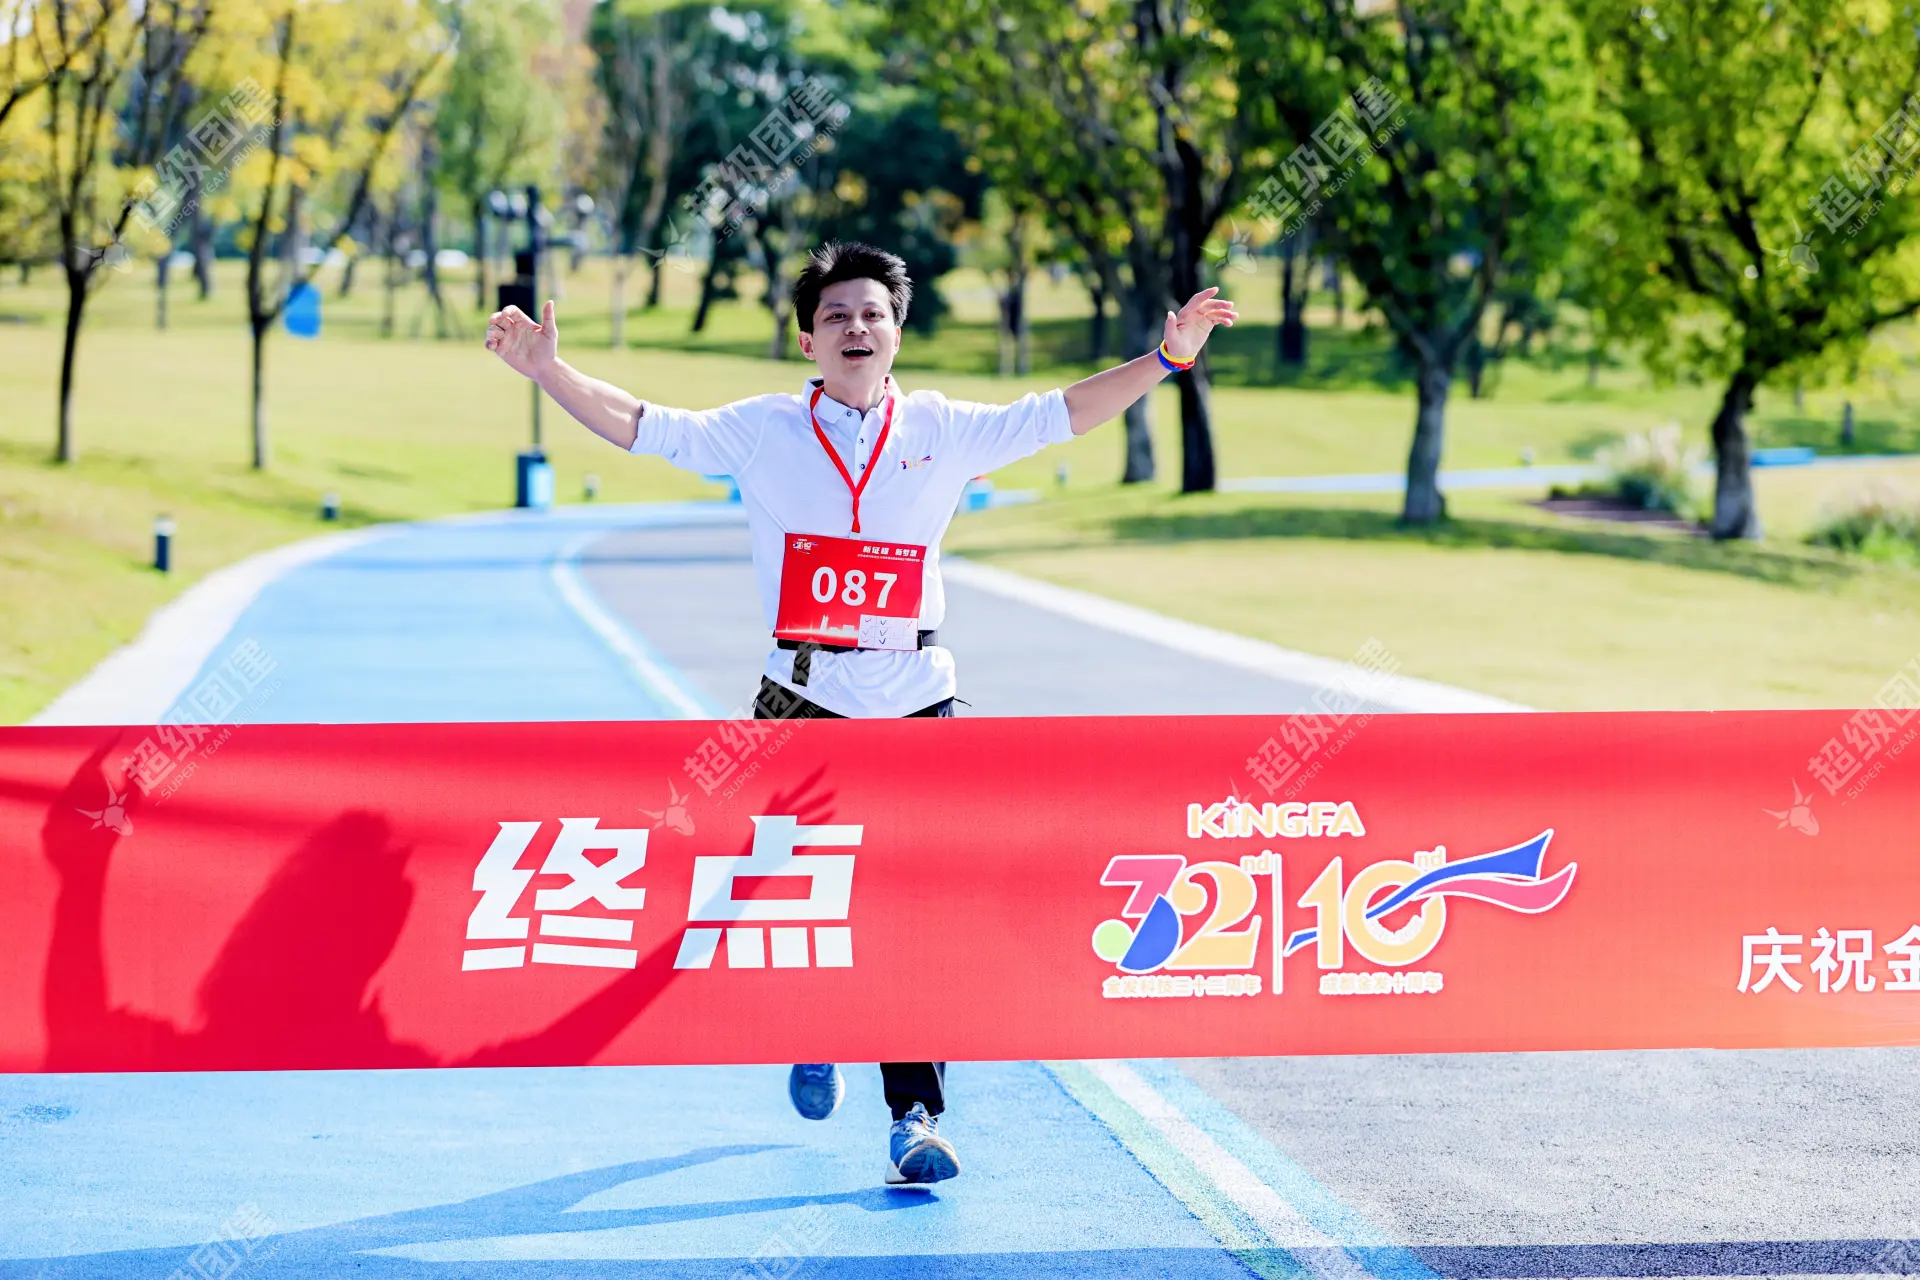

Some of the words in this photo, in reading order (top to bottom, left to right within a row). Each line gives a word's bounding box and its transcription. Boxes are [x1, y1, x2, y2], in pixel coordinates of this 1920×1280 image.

[811, 566, 898, 609] 087
[462, 815, 864, 971] 终点
[1103, 975, 1261, 997] 金发科技三十二周年
[1319, 972, 1443, 994] 成都金发十周年
